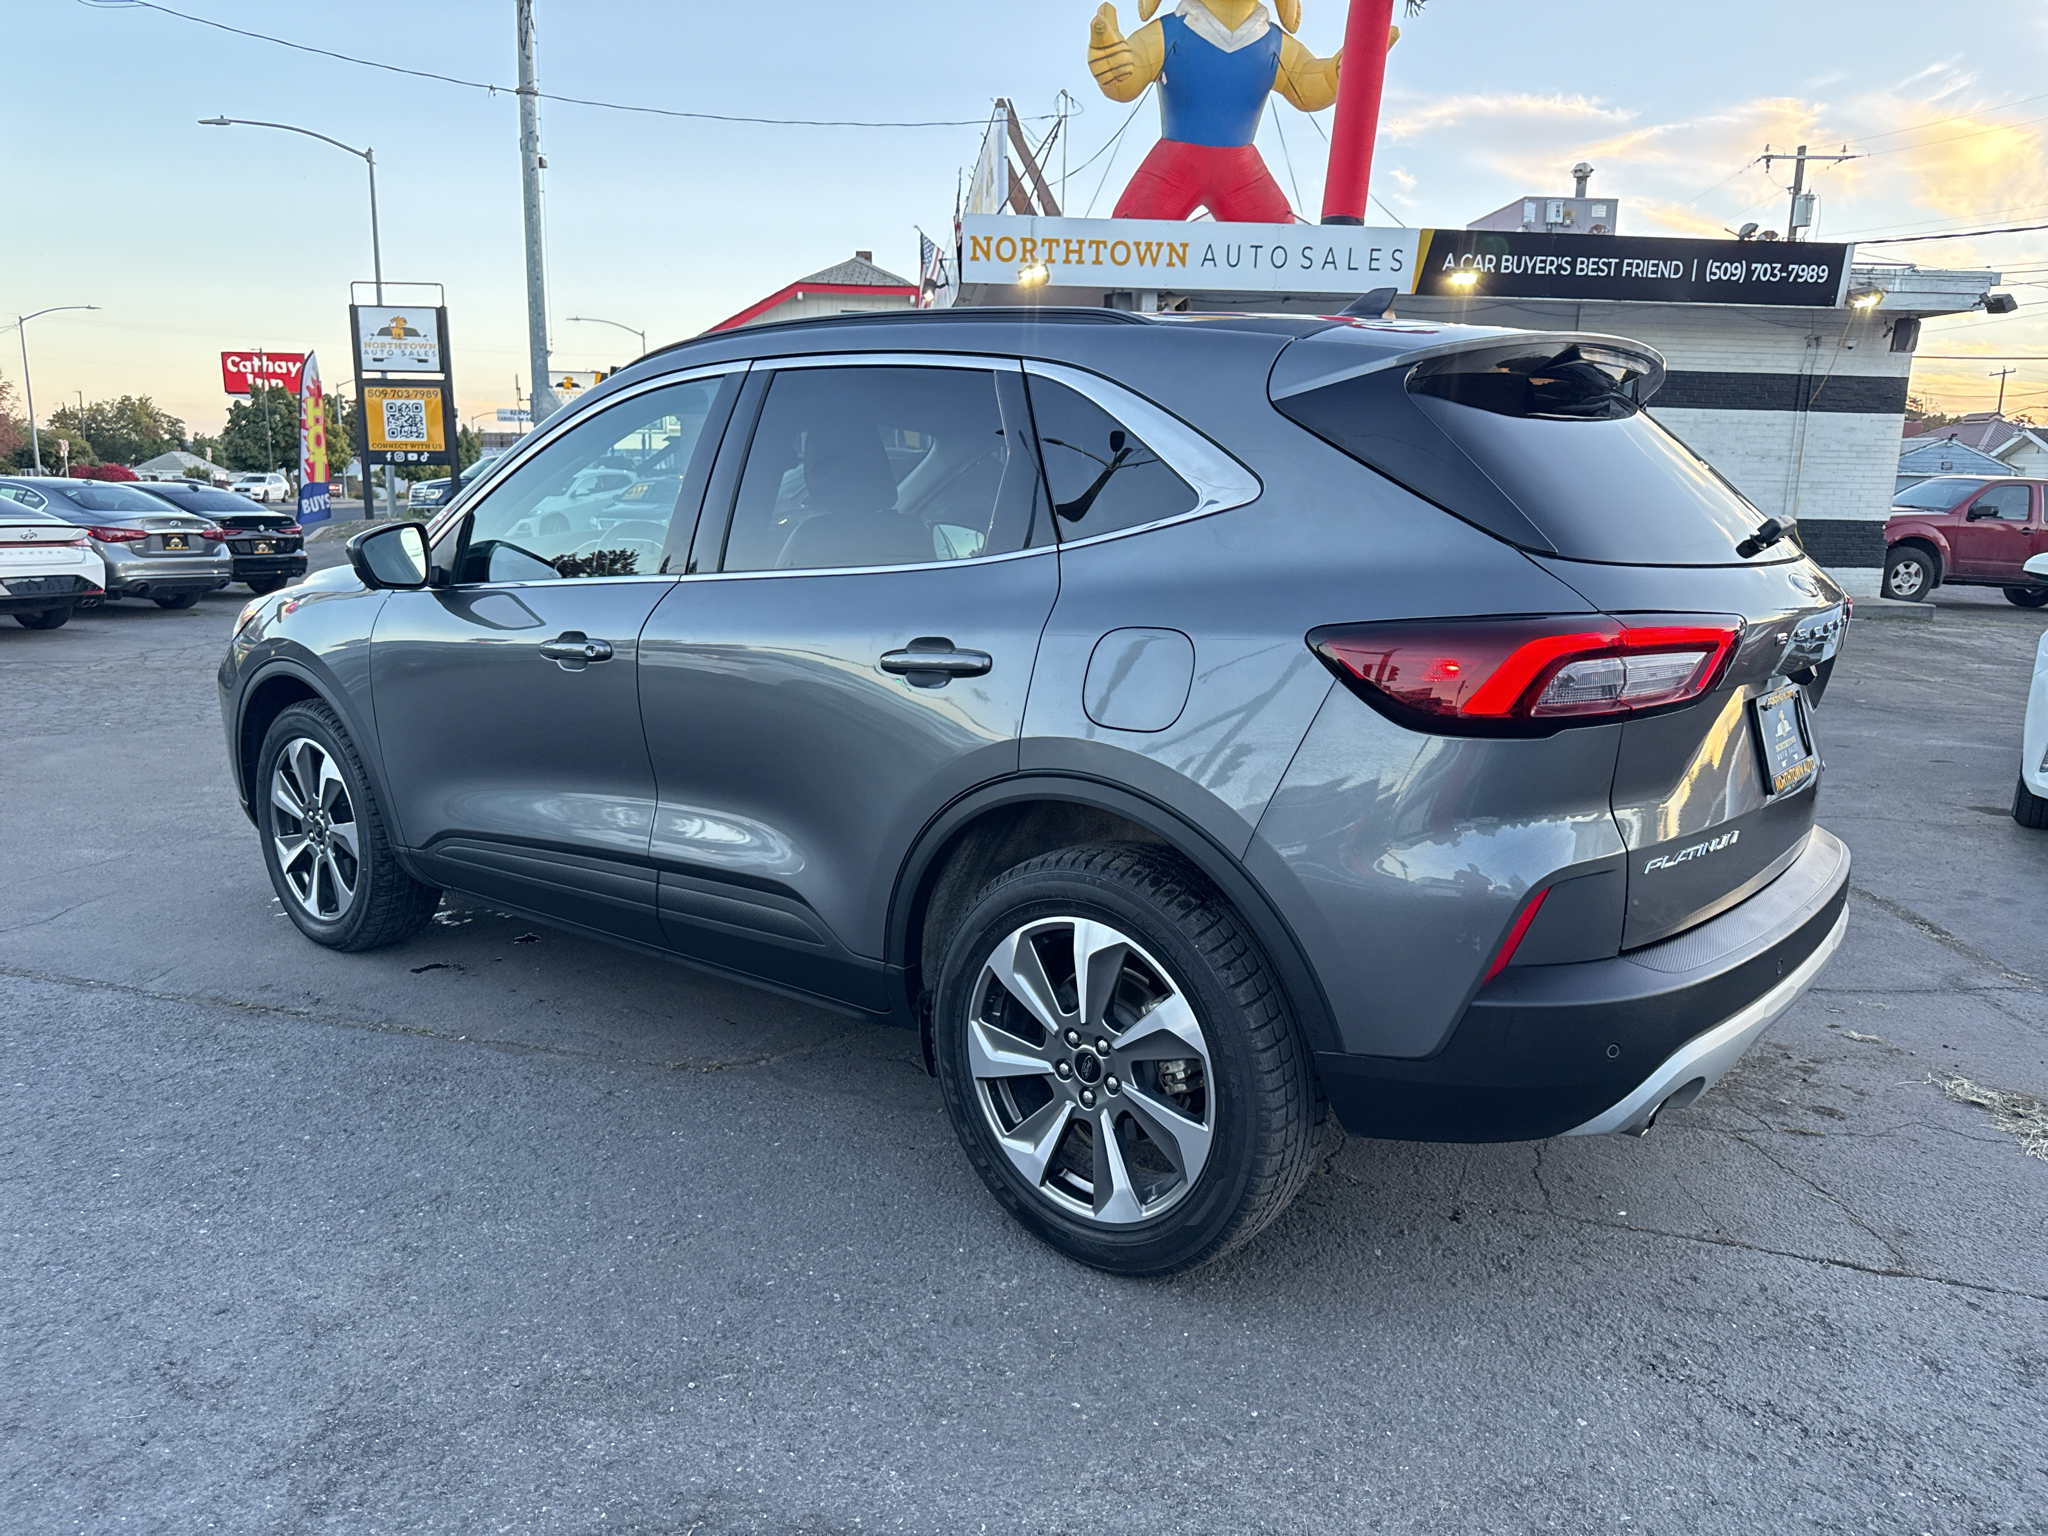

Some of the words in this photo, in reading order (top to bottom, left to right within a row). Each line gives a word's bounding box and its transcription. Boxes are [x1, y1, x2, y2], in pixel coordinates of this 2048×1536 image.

[970, 235, 1190, 268] NORTHTOWN
[1201, 243, 1288, 269] AUTO
[1300, 245, 1404, 272] SALES
[1442, 253, 1455, 272] A
[1461, 253, 1497, 273] CAR
[1500, 255, 1572, 276] BUYER'S
[1575, 257, 1620, 277] BEST
[1621, 259, 1684, 279] FRIEND
[1705, 259, 1747, 284] (509)
[1750, 262, 1829, 284] 703-7989
[363, 341, 437, 350] NORTHTOWN
[363, 349, 395, 357] AUTO
[401, 349, 438, 358] SALES
[226, 355, 302, 378] Cathay
[306, 396, 328, 483] HOT
[372, 442, 409, 451] CONNECT
[410, 443, 431, 451] WITH
[432, 443, 443, 451] US
[301, 492, 331, 515] BUYS
[1642, 829, 1741, 875] PLATINUM
